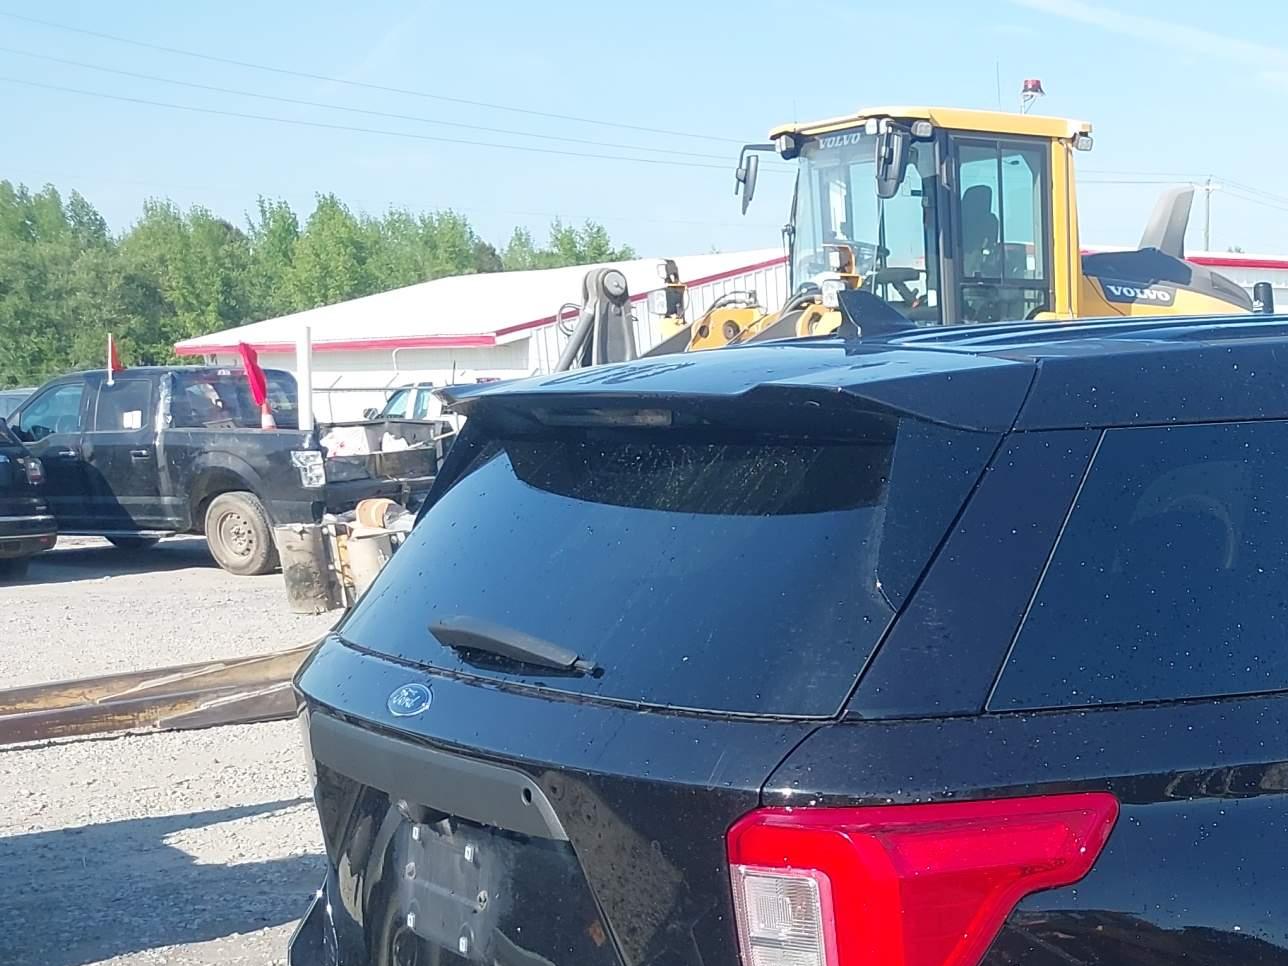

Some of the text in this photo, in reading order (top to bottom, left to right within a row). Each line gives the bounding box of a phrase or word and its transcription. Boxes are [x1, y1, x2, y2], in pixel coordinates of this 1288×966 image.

[816, 133, 861, 150] VOLVO
[1106, 285, 1171, 301] VOLVO
[392, 688, 421, 708] Ford
